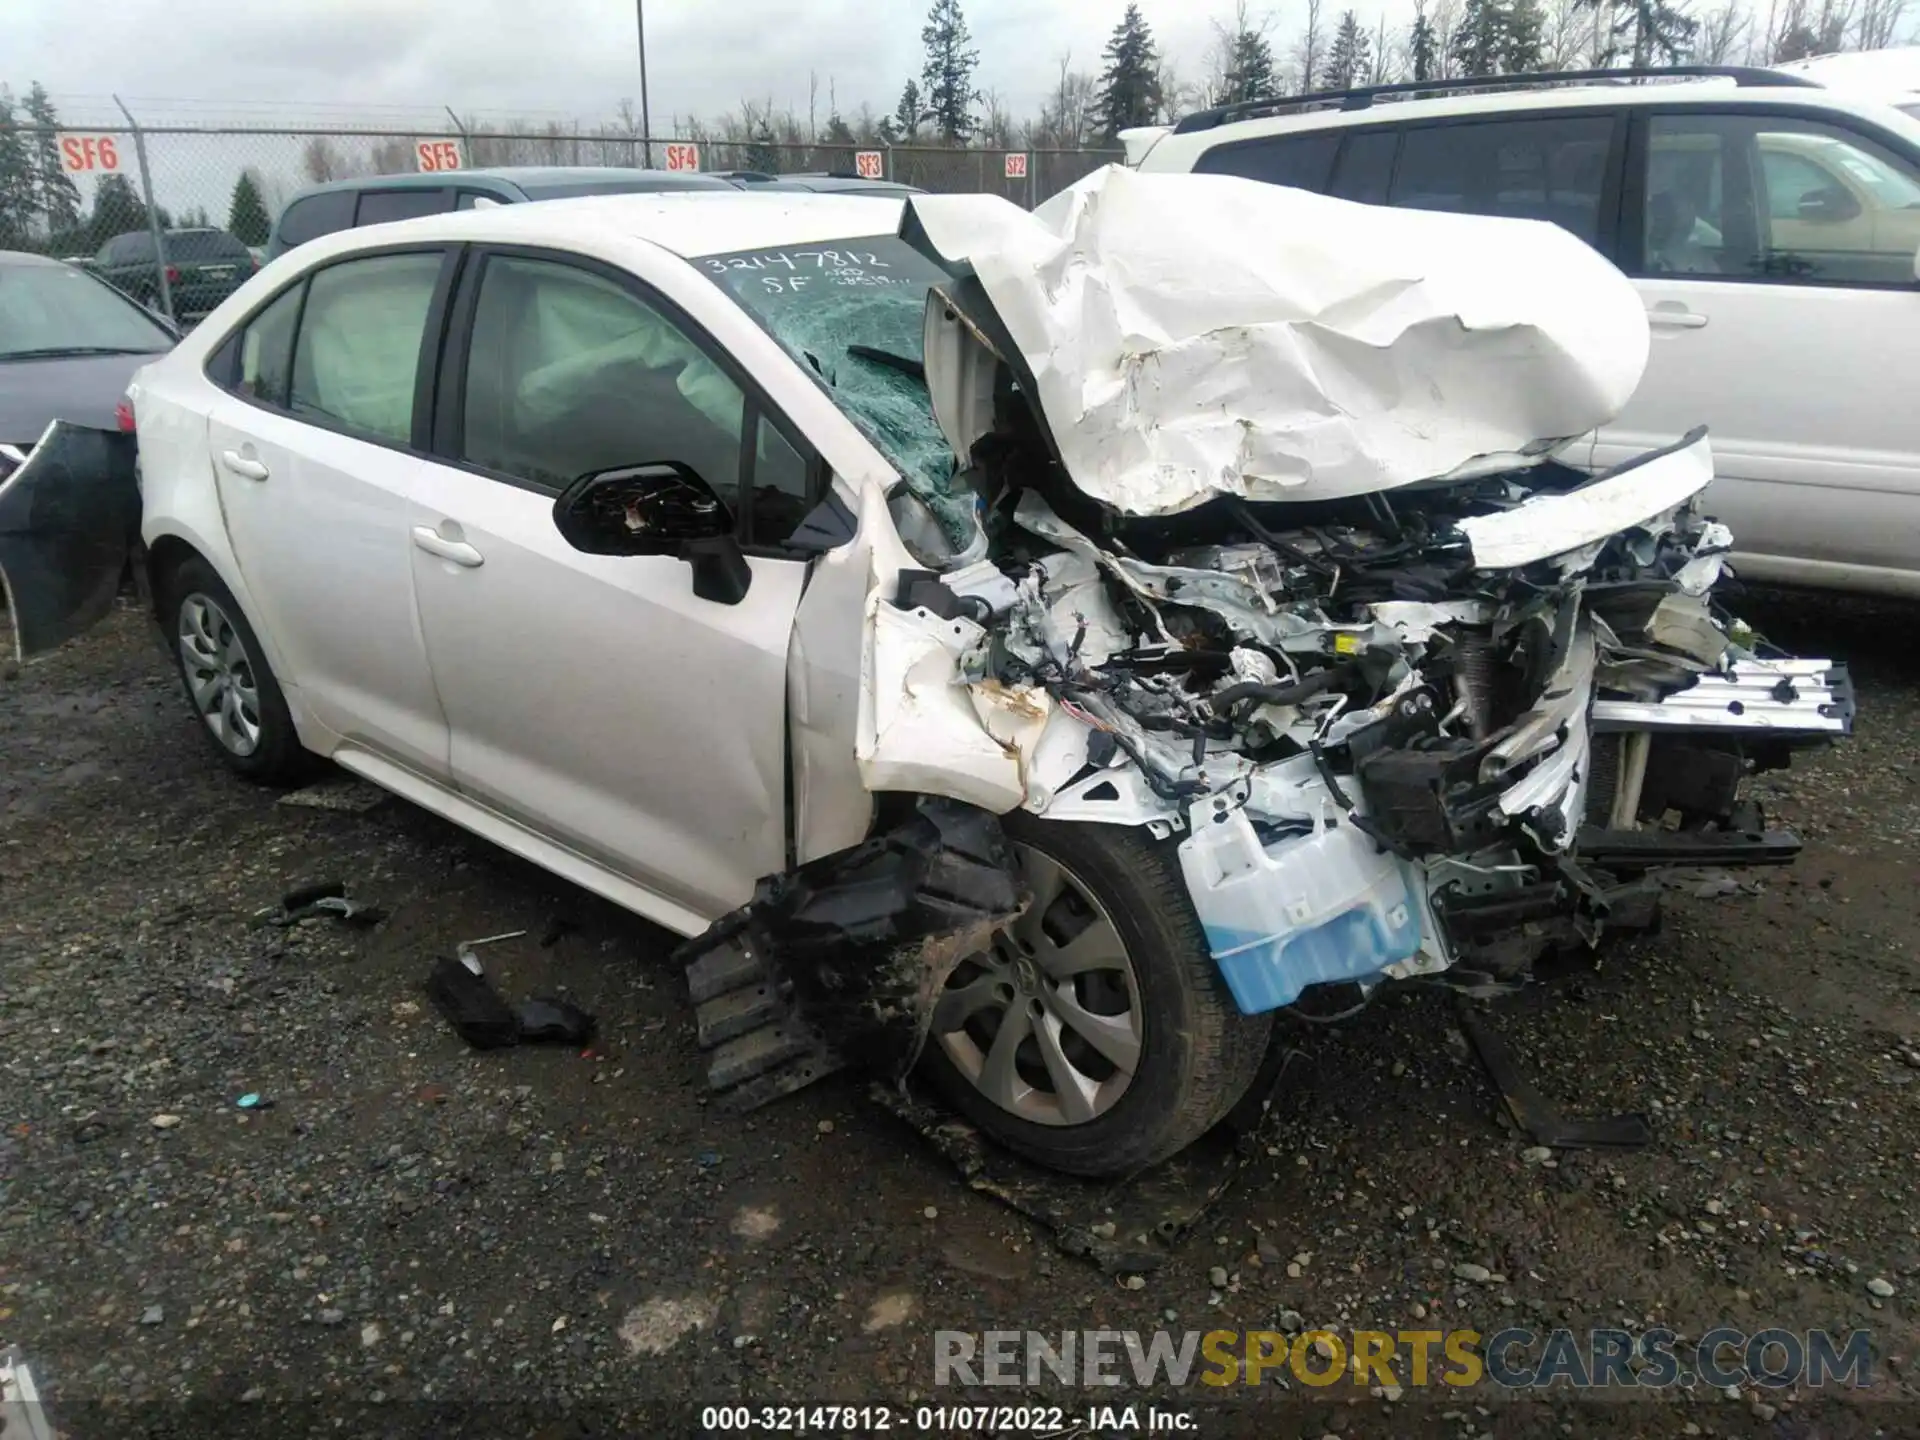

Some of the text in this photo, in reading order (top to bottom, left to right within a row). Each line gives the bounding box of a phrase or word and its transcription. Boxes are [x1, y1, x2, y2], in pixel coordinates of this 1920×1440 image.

[63, 136, 117, 170] SF6
[419, 142, 458, 171] SF5
[667, 145, 697, 170] SF4
[858, 153, 880, 176] SF3
[1007, 155, 1025, 175] SF2
[705, 250, 891, 274] 32147812
